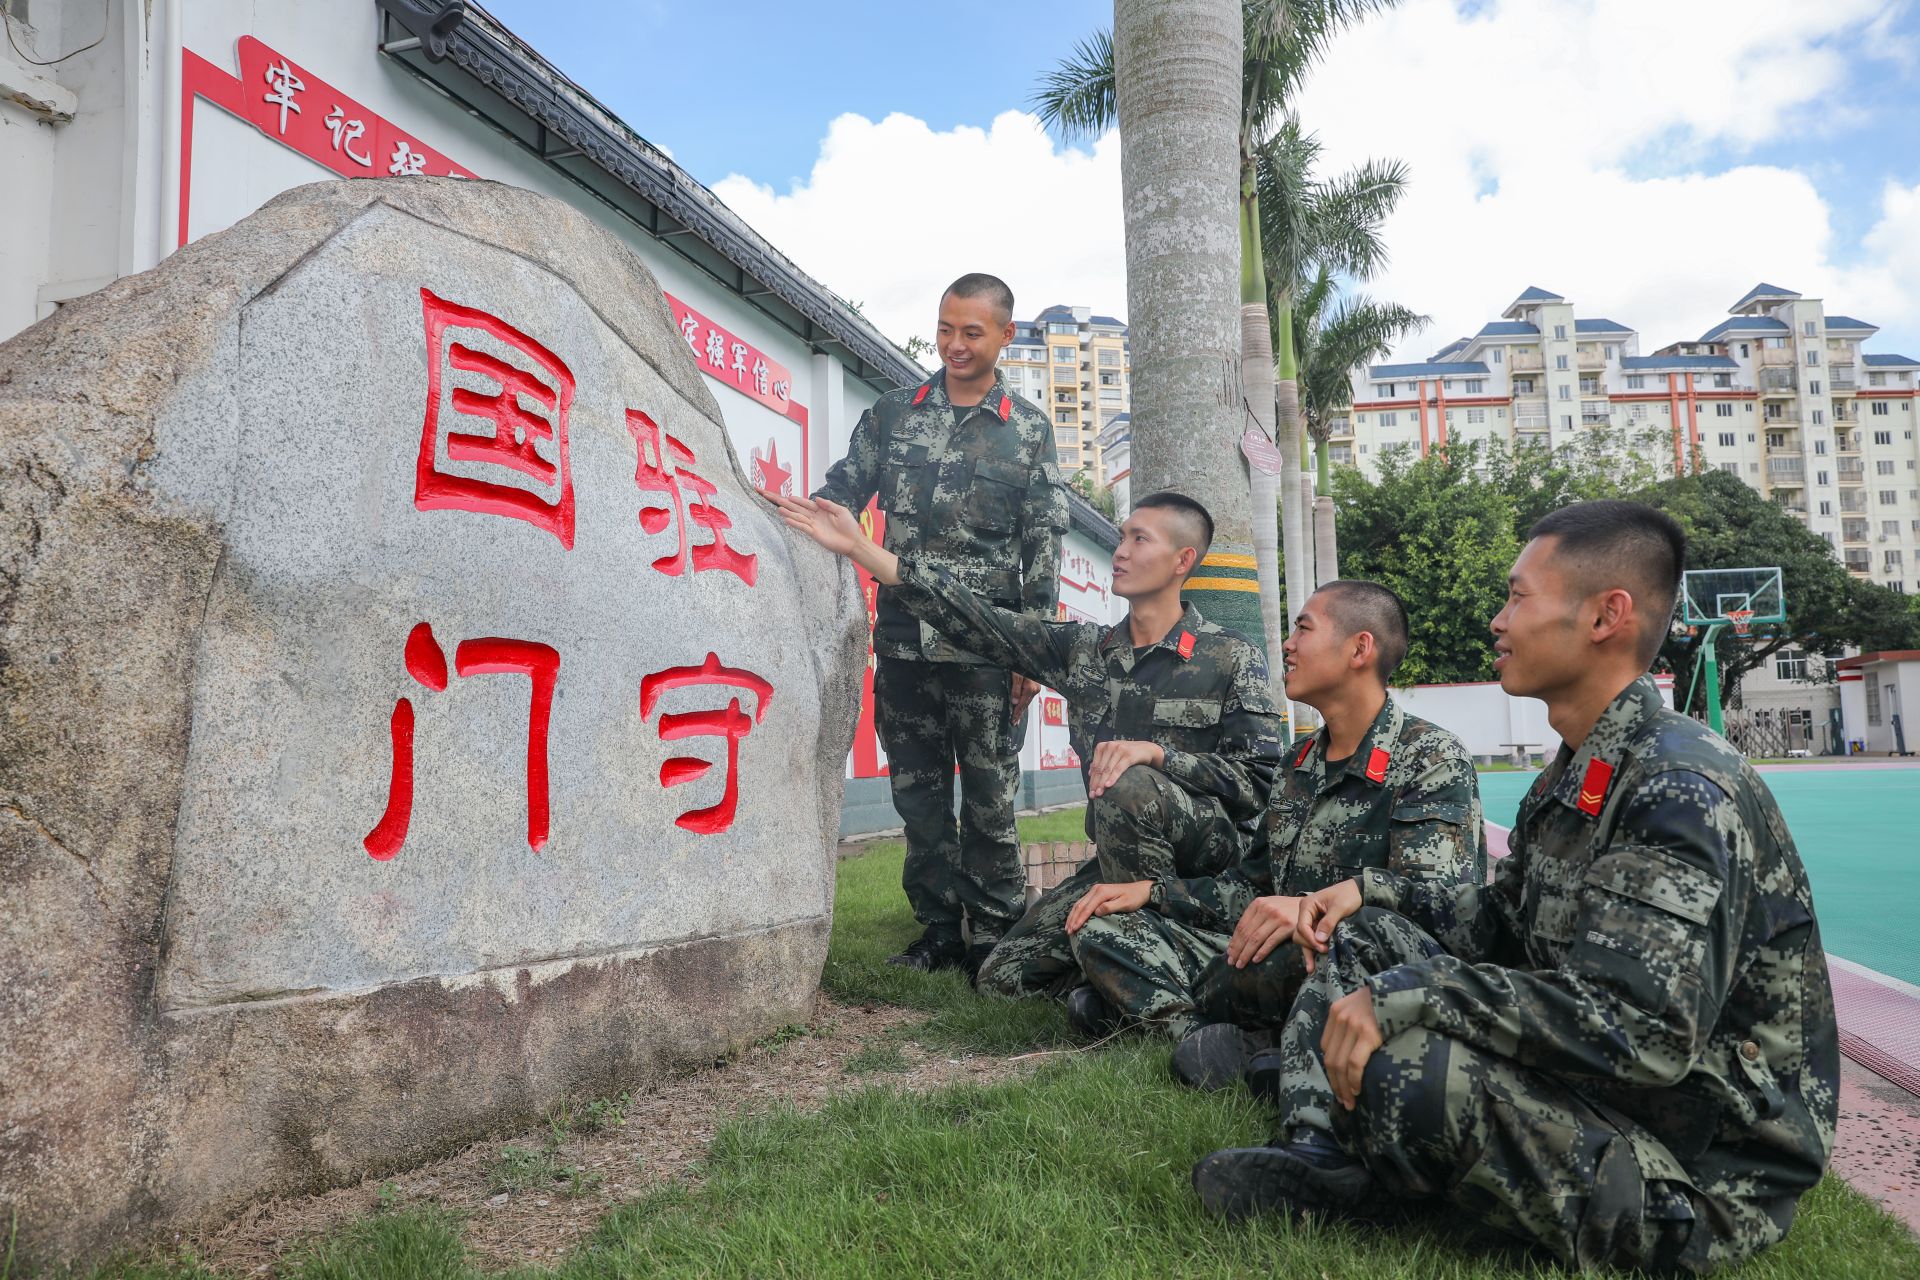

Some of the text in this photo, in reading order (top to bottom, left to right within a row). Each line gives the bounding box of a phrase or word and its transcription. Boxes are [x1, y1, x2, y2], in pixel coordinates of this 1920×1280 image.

[264, 60, 468, 178] 牢记强
[681, 312, 790, 401] 定强军信心
[363, 287, 576, 861] 国门
[625, 408, 775, 835] 驻守
